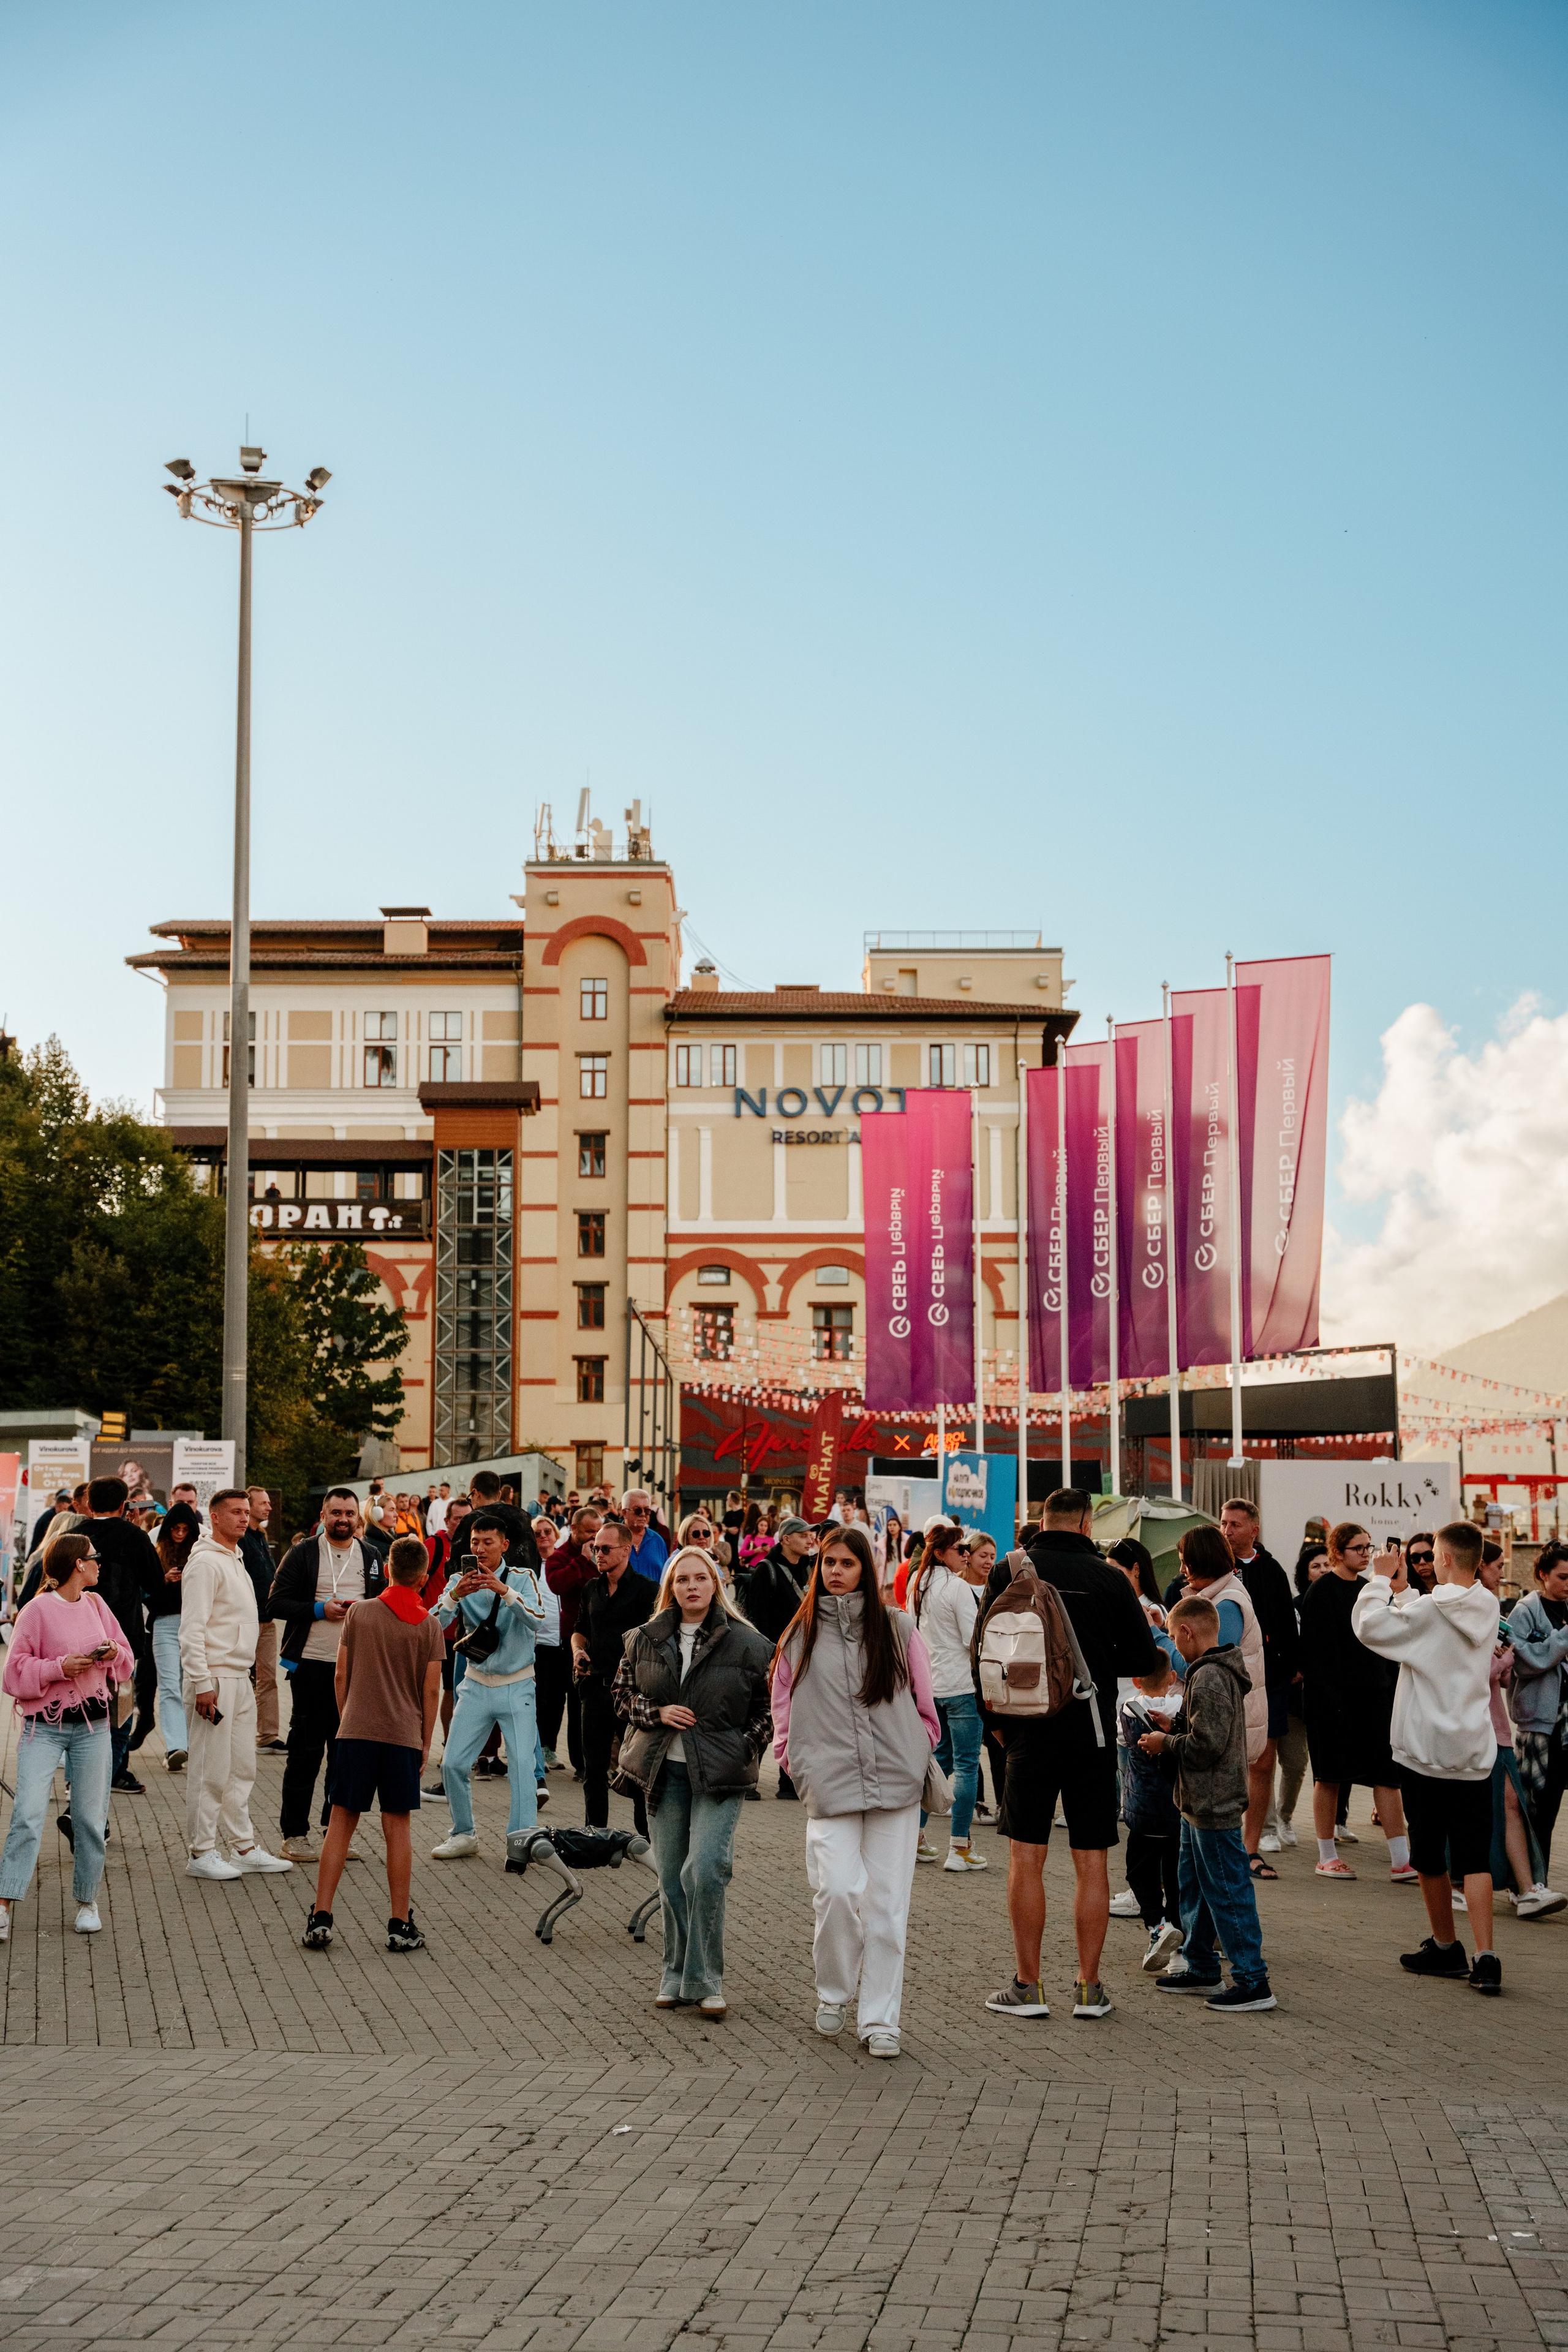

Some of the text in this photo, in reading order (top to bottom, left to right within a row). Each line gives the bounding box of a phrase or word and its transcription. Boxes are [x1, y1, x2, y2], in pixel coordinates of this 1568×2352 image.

[772, 1130, 842, 1144] RESORT
[1277, 1058, 1298, 1147] Первый
[1093, 1126, 1110, 1267] СБЕР Первый
[1147, 1109, 1165, 1256] СБЕР Первый
[1200, 1082, 1221, 1237] СБЕР Первый
[812, 1431, 835, 1514] МАГНАТ
[1346, 1482, 1426, 1517] Rokky
[1371, 1516, 1400, 1525] home
